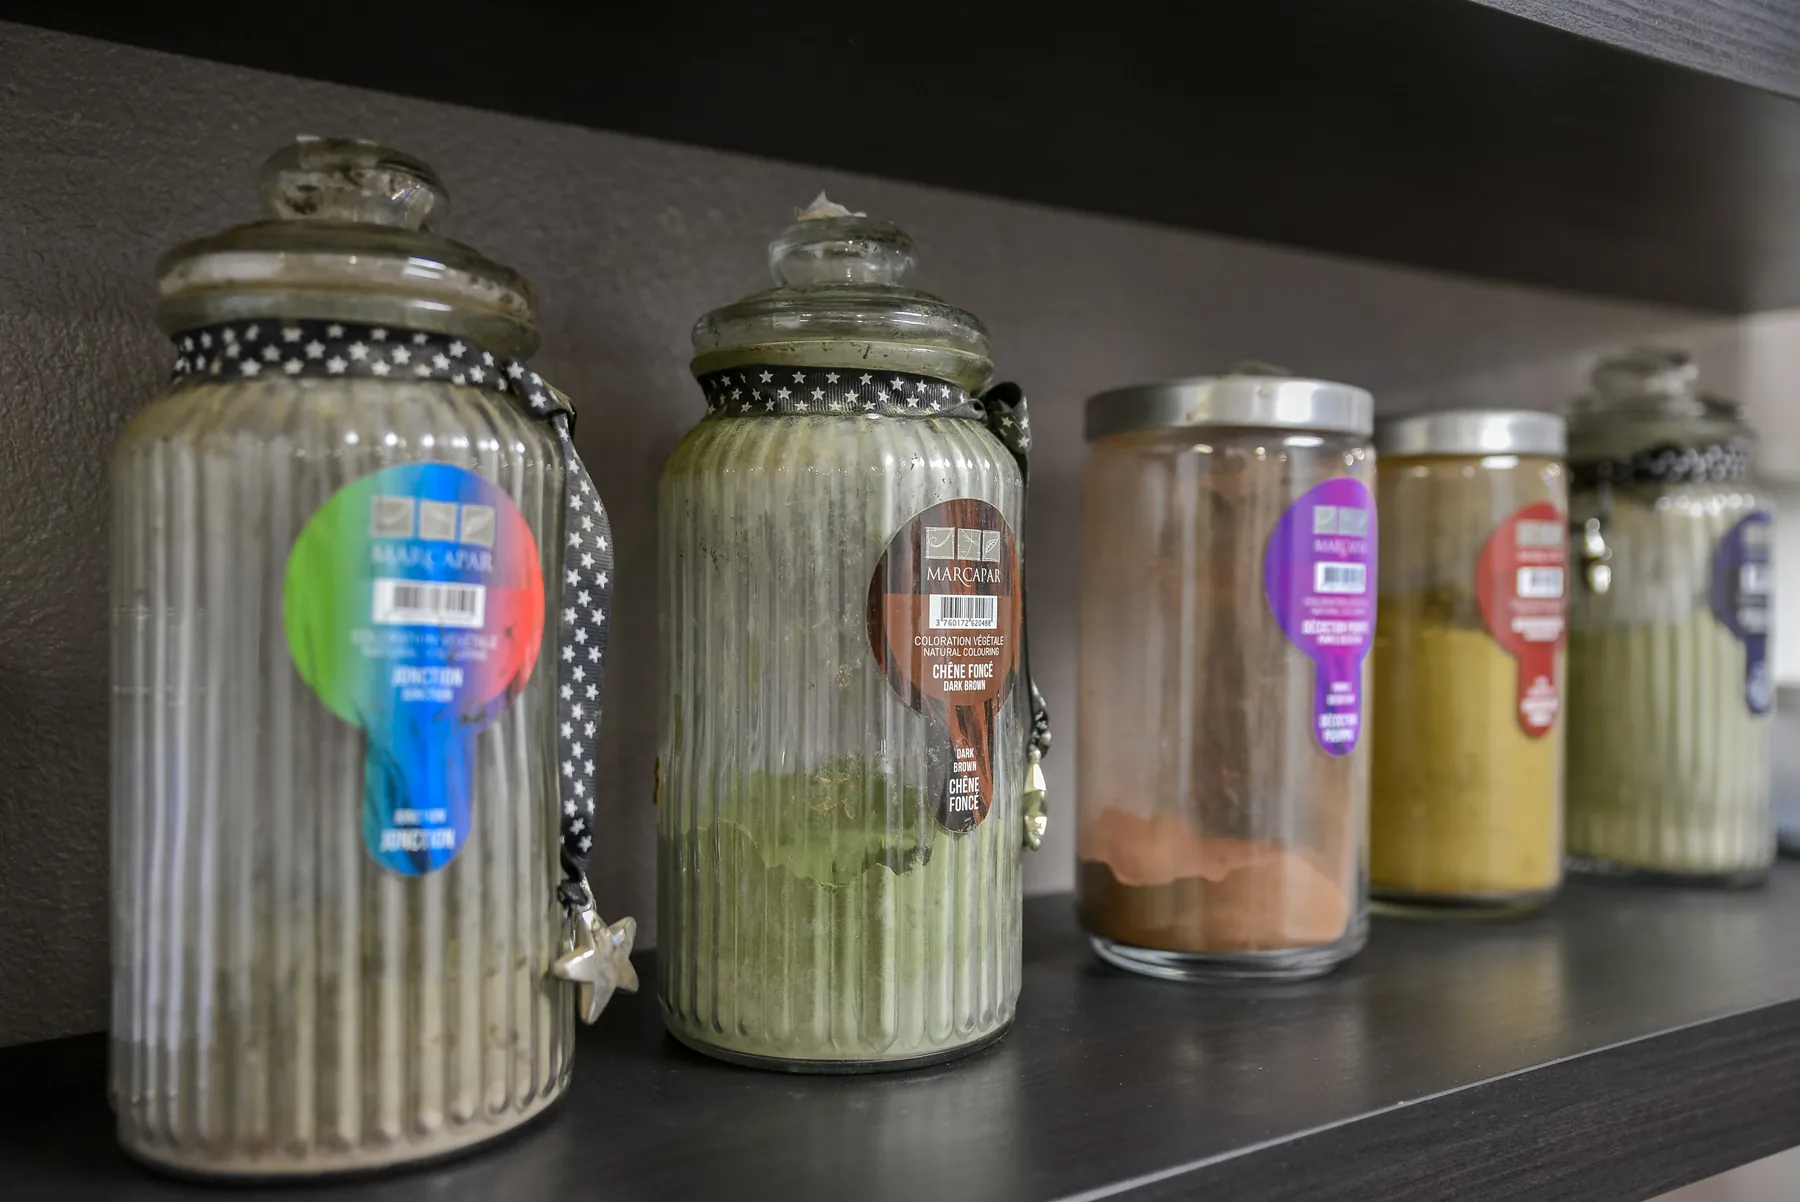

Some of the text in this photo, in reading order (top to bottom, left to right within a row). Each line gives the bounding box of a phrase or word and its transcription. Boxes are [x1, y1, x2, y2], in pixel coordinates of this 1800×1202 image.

[927, 567, 1001, 588] MARCAPAR
[936, 619, 991, 627] 3 760172 620488
[914, 634, 1004, 646] COLORATION VÉGÉTALE
[923, 647, 1000, 657] NATURAL COLOURING
[932, 661, 993, 680] CHÊNE FONCÉ
[943, 679, 986, 692] DARK BROWN
[956, 747, 974, 760] DARK
[953, 761, 977, 773] BROWN
[949, 776, 980, 794] CHÊNE
[949, 793, 979, 812] FONCÉ
